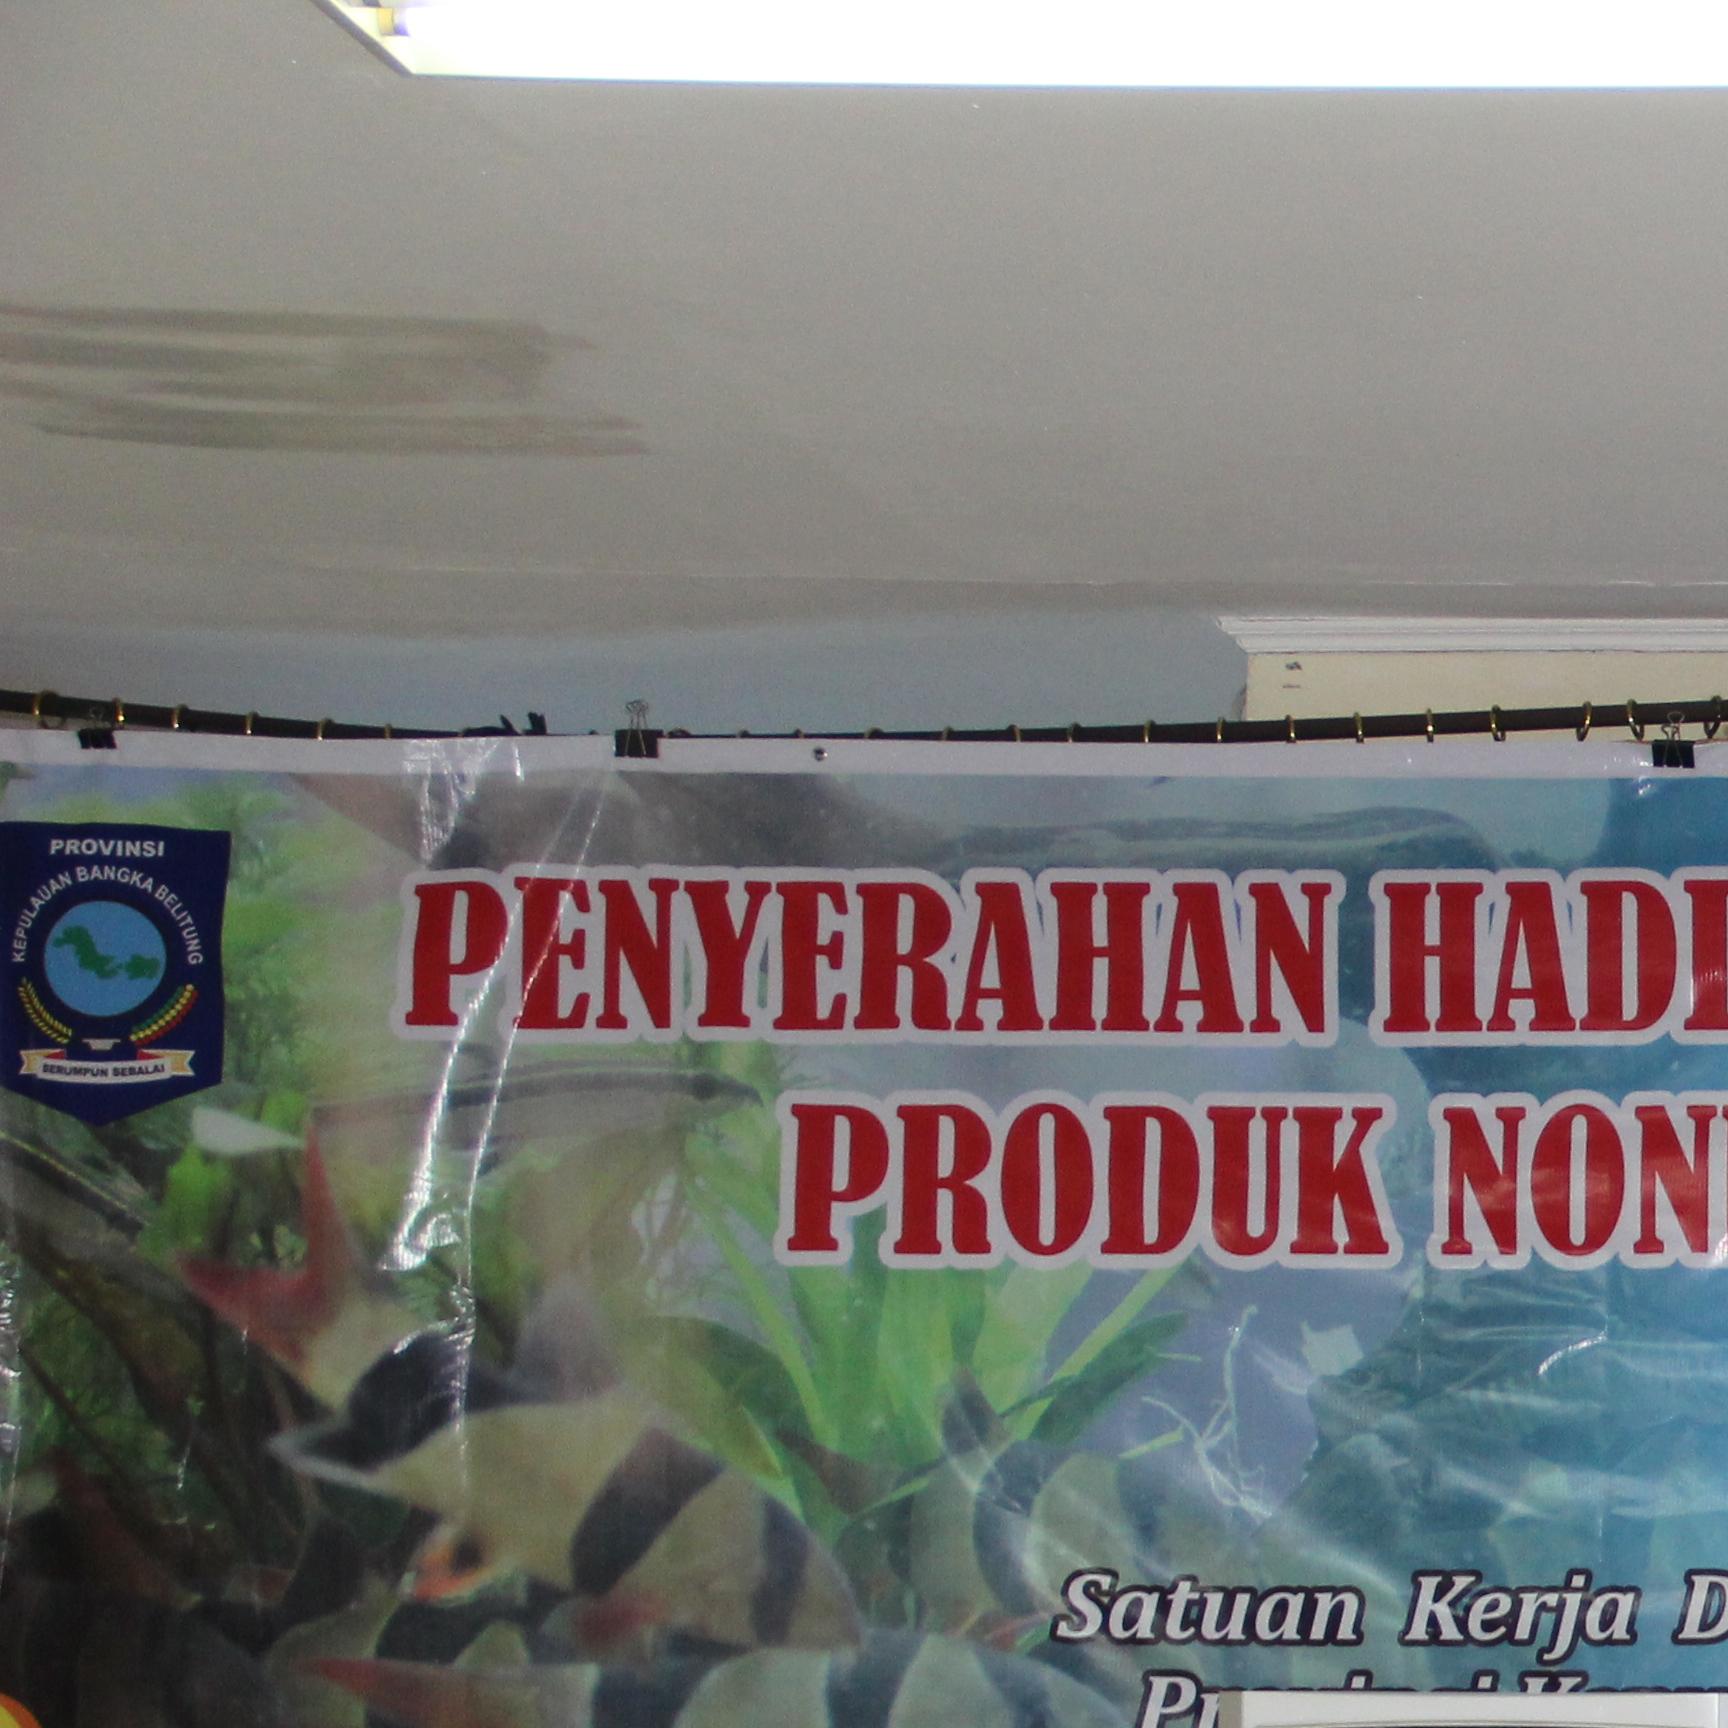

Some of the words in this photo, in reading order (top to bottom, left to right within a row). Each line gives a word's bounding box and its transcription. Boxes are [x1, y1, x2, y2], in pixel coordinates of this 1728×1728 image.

[49, 838, 165, 857] PROVINSI
[12, 870, 73, 963] KEPULAUAN
[75, 864, 154, 893] BANGKA
[154, 884, 204, 966] BELITUNG
[405, 876, 1334, 1034] PENYERAHAN
[41, 1062, 109, 1079] BERUMPUN
[111, 1062, 166, 1078] SEBALAI
[787, 1101, 1391, 1256] PRODUK
[1054, 1570, 1361, 1643] Satuan
[1402, 1571, 1637, 1660] Kerja
